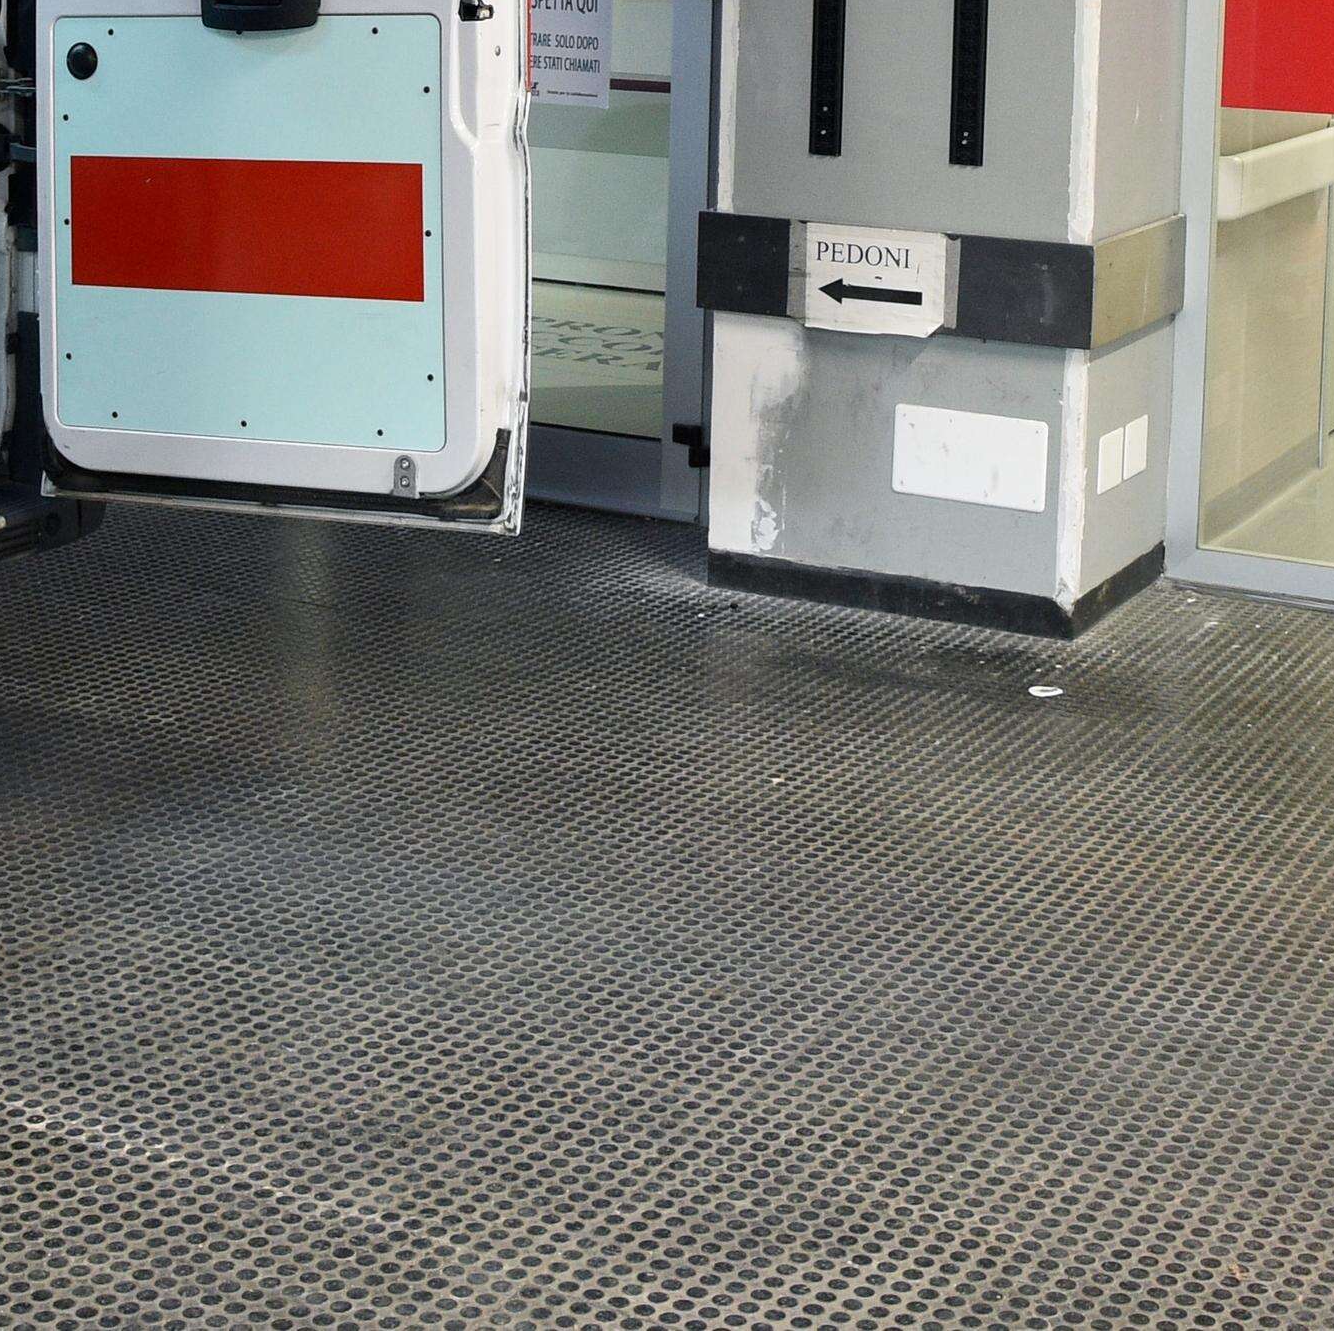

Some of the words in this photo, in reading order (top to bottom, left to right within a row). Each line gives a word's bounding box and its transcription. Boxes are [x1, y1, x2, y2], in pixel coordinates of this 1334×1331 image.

[554, 33, 576, 49] SOLO
[576, 35, 599, 51] DOPO
[543, 56, 563, 71] STATI
[563, 57, 601, 74] CHIAMATI
[816, 240, 911, 270] PEDONI
